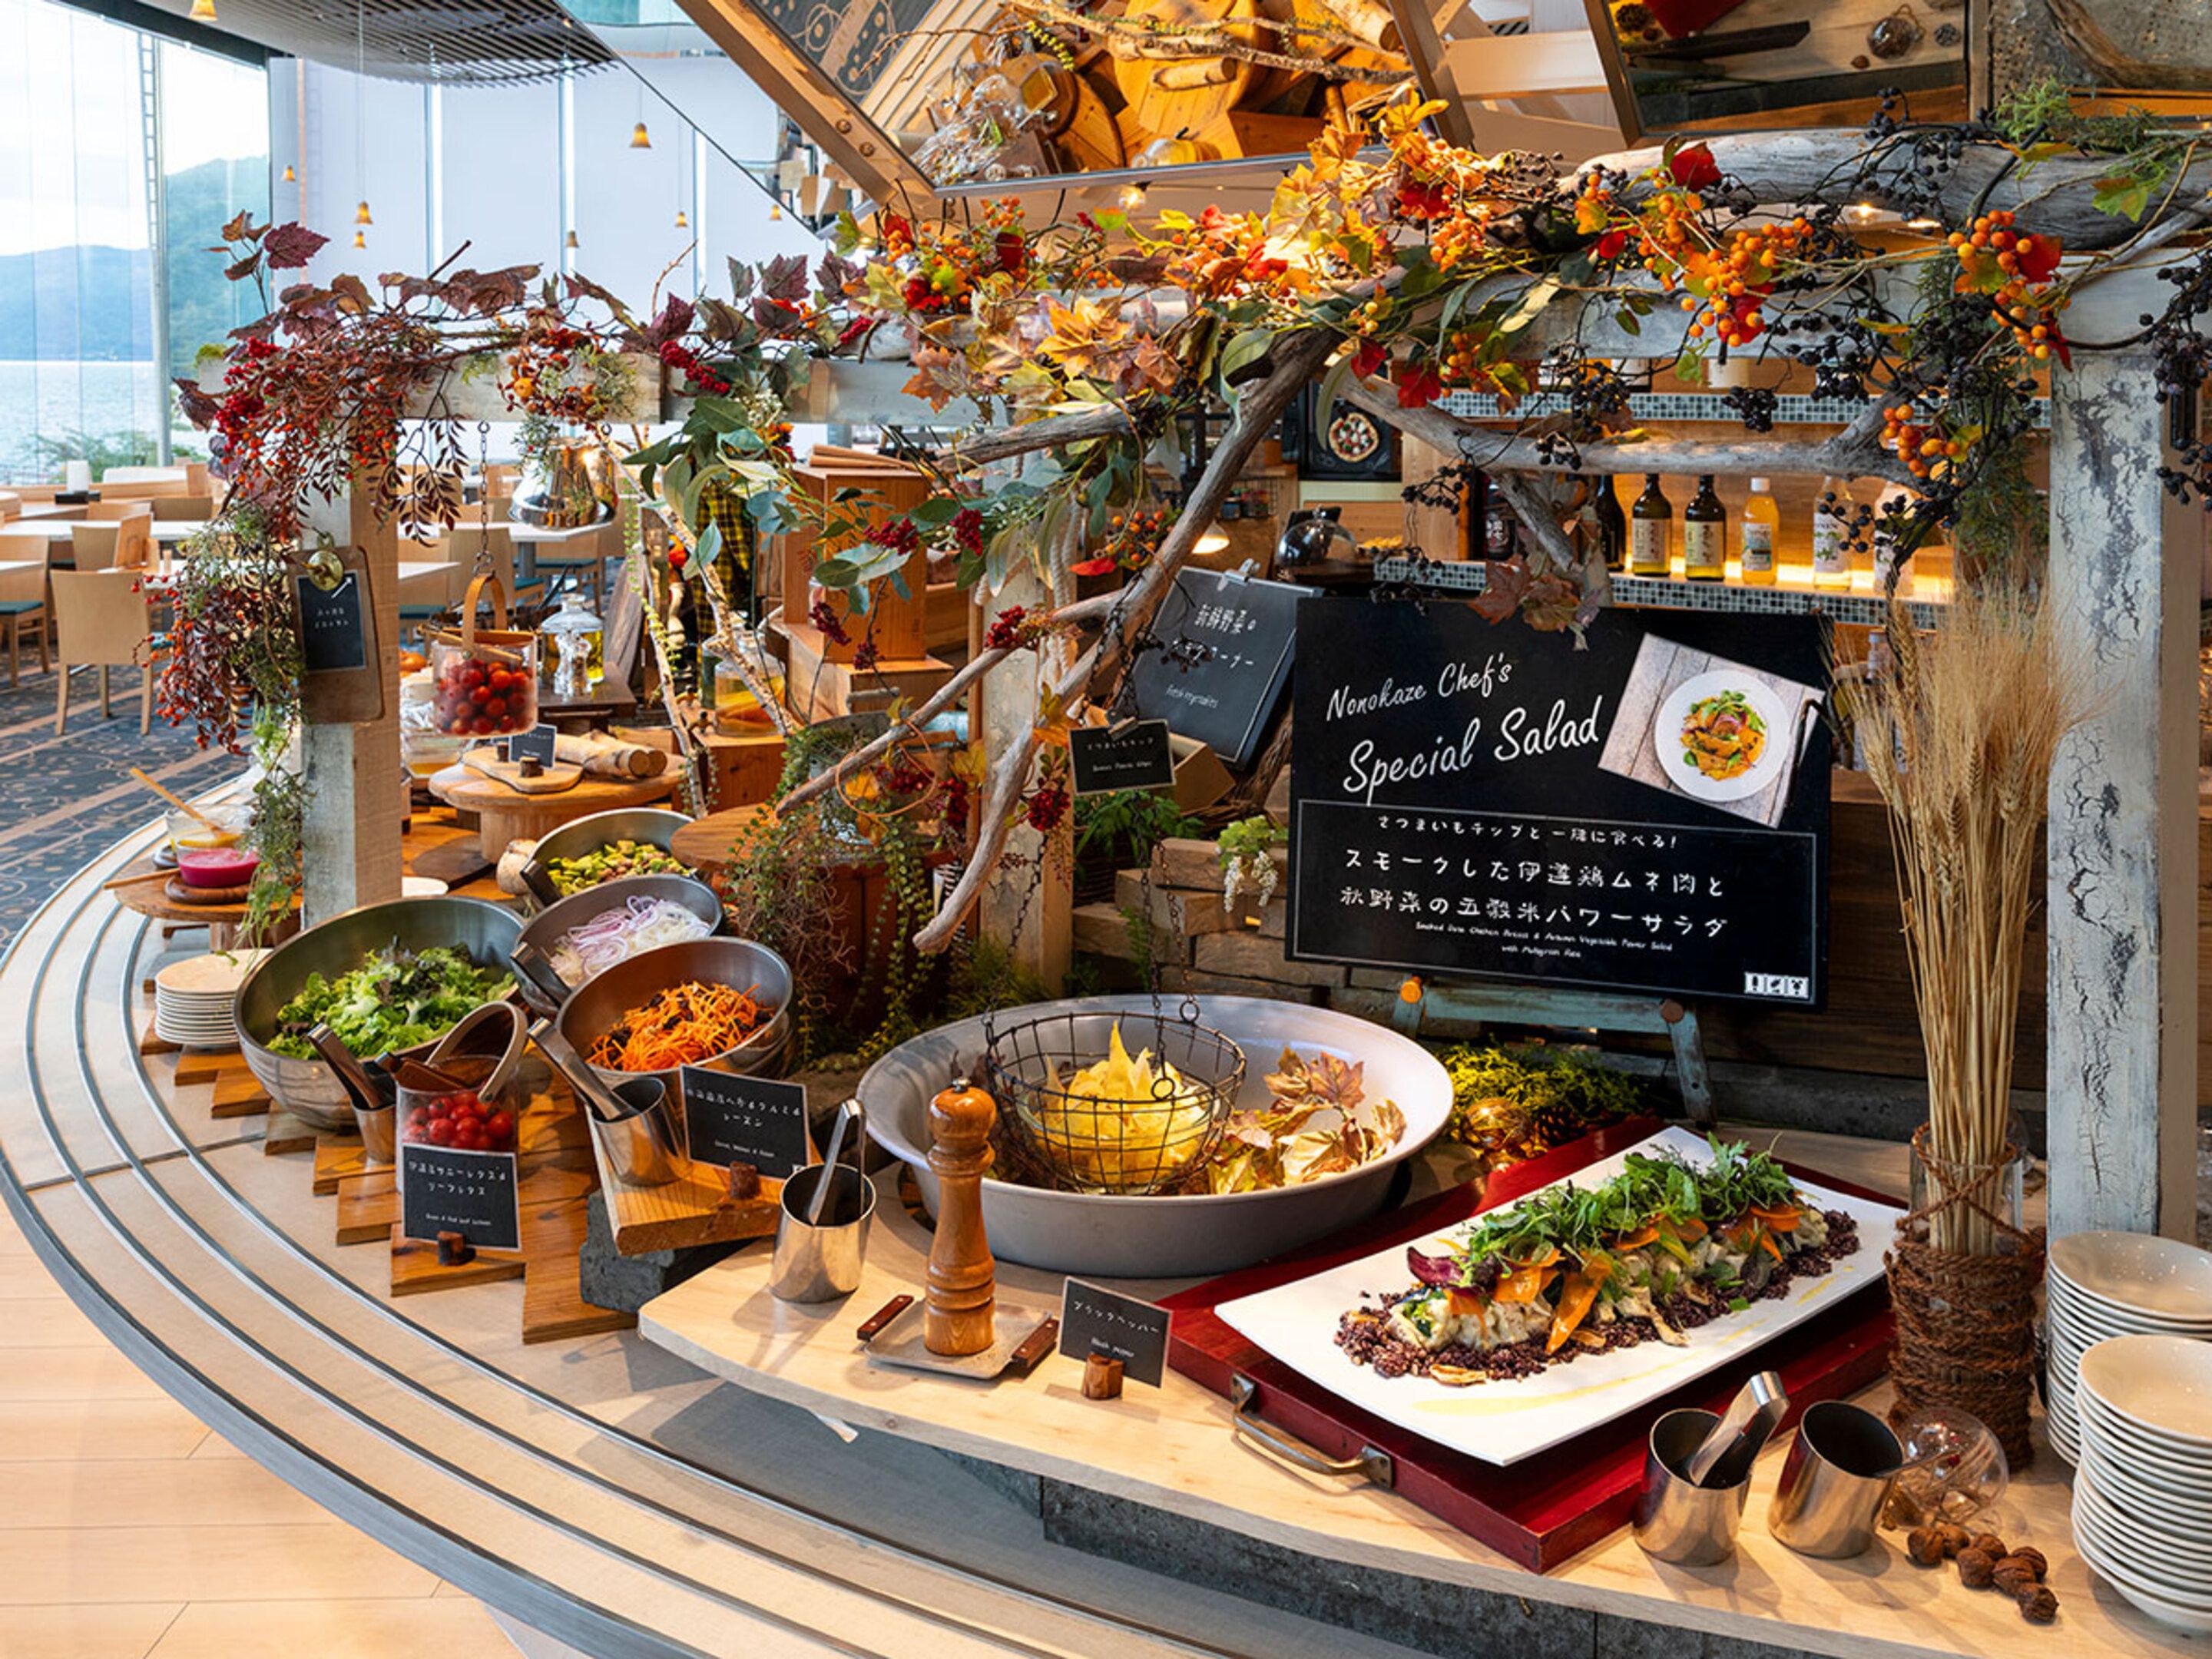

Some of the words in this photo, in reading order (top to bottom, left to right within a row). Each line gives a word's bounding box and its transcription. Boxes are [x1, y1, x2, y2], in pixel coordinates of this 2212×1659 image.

[1326, 678, 1427, 722] Nonokaze
[1438, 653, 1512, 698] Chef's
[1343, 717, 1482, 807] Special
[1493, 694, 1603, 762] Salad
[1346, 849, 1723, 897] スモークした伊達鶏ムネ肉と
[1340, 886, 1728, 938] 秋野菜の五穀米パワーサラダ
